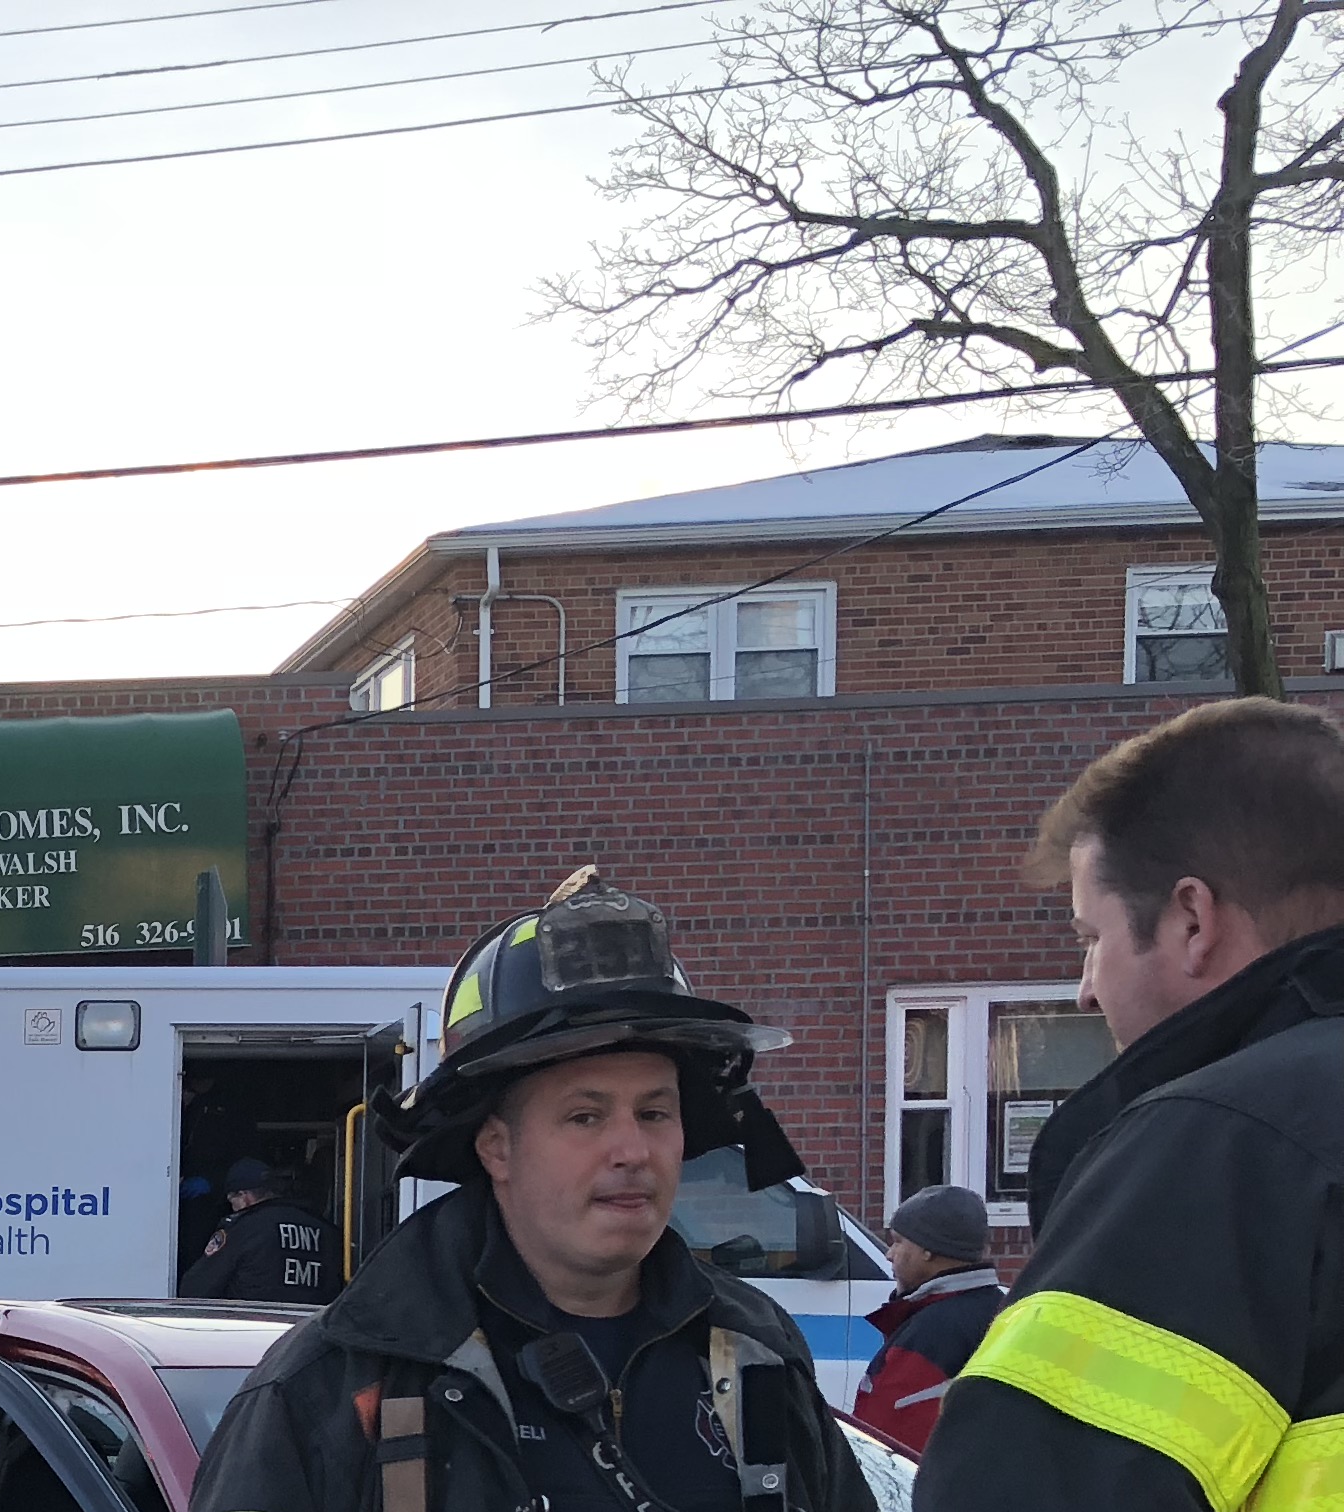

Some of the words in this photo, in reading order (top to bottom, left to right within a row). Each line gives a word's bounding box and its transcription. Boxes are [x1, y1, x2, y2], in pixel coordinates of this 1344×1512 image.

[119, 802, 190, 835] INC.
[80, 923, 120, 947] 516
[279, 1223, 321, 1252] FDNY
[284, 1258, 322, 1287] EMT
